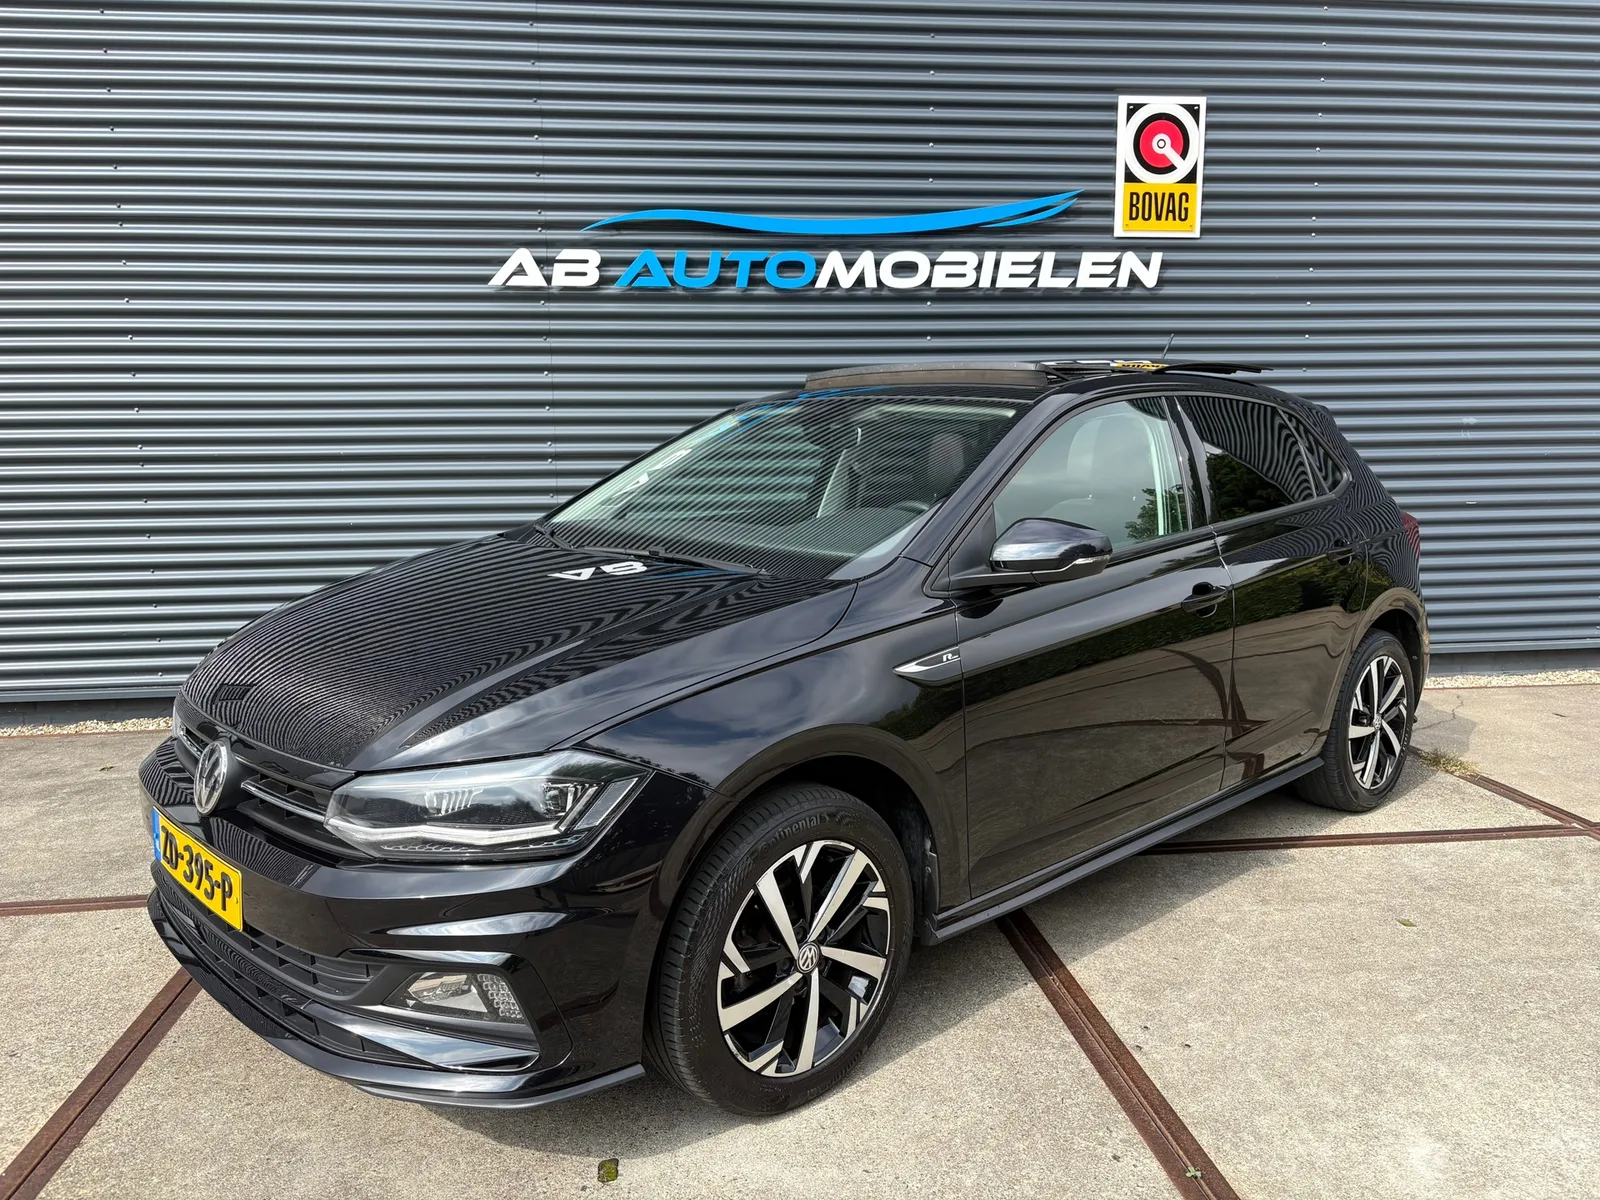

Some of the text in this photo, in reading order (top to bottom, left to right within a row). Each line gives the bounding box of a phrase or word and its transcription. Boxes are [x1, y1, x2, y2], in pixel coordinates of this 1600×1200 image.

[1129, 191, 1190, 222] BOVAG
[487, 247, 1164, 289] AB AUTOMOBIELEN
[161, 825, 233, 912] ZD-395-P
